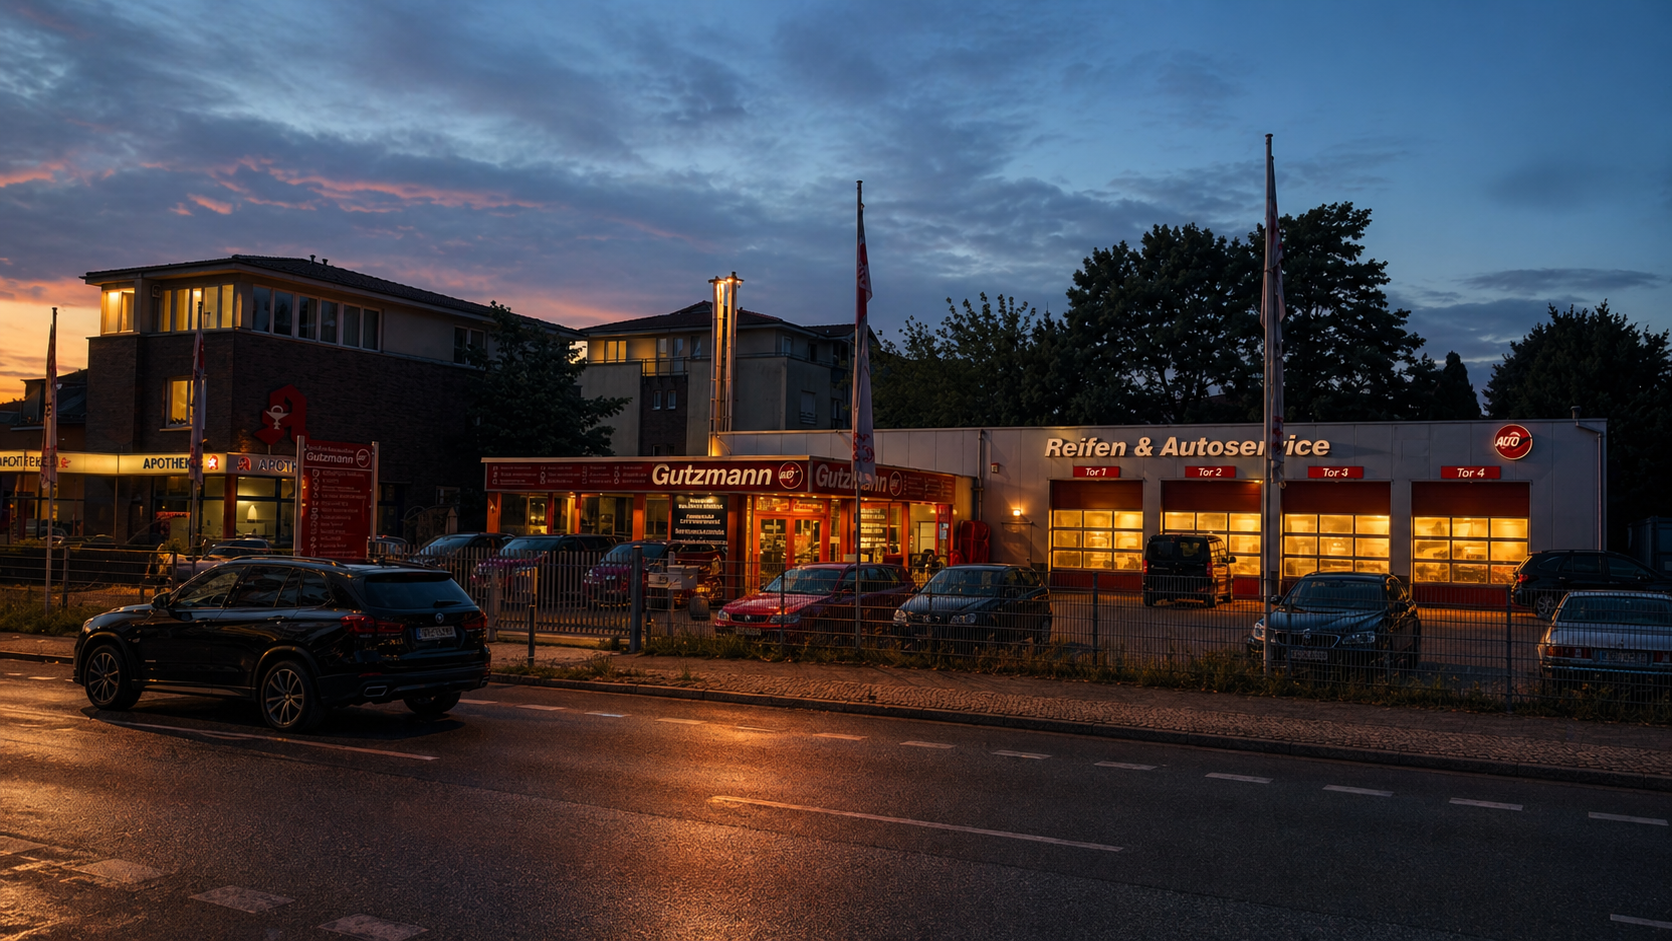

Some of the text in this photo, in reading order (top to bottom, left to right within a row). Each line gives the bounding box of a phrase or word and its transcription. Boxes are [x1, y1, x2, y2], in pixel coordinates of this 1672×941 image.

[1045, 433, 1331, 457] Reifen & Autoserice
[143, 457, 191, 469] APOTHEK
[306, 452, 354, 464] Gutzmann
[652, 463, 772, 485] Gutzmann
[1085, 468, 1100, 476] Tor
[1198, 467, 1222, 477] Tor 2
[1322, 467, 1349, 477] Tor 3
[1457, 468, 1485, 477] Tor 4
